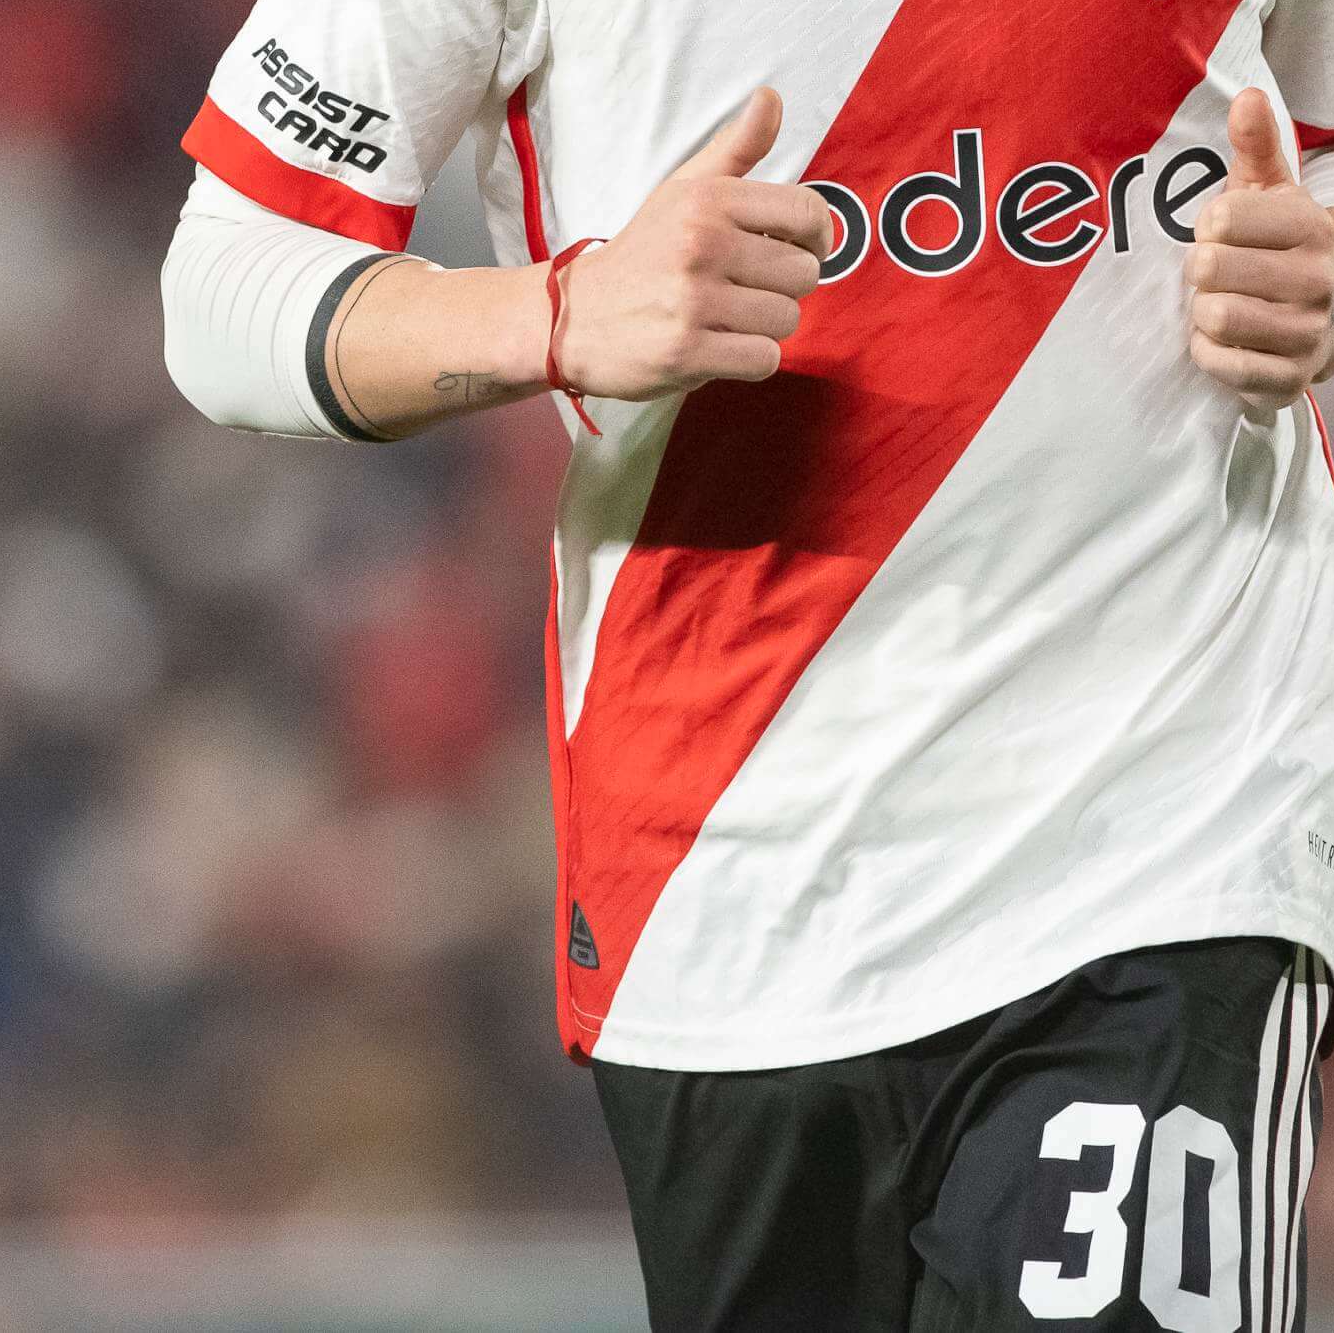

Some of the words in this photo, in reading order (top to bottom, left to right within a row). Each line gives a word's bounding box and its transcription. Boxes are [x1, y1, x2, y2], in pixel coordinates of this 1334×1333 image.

[252, 38, 390, 133] ASSIST
[258, 91, 387, 173] CARD
[1019, 1102, 1242, 1333] 30
